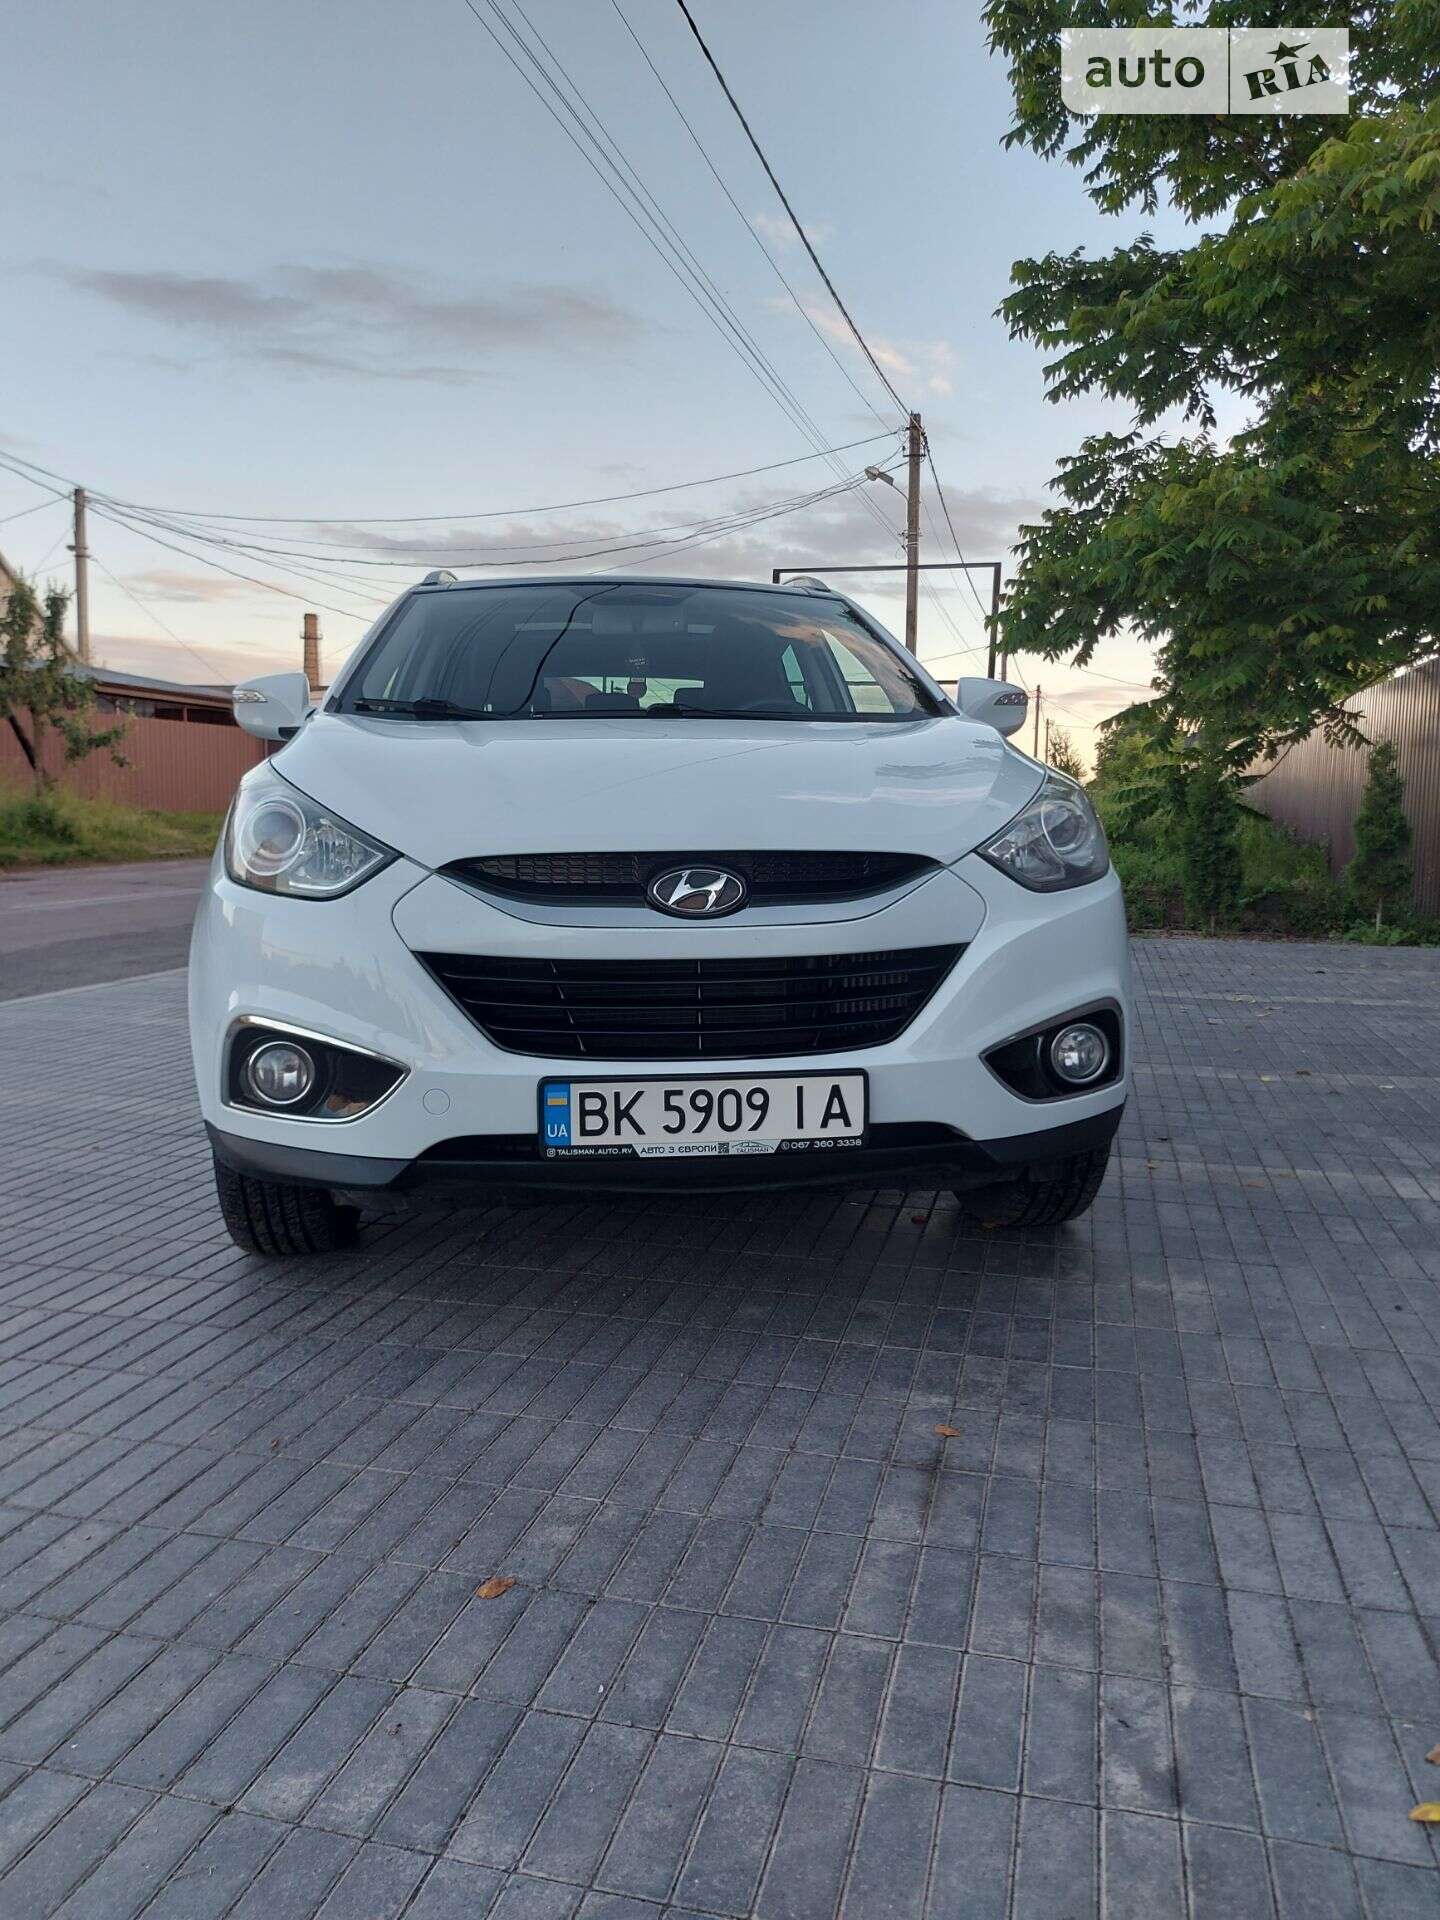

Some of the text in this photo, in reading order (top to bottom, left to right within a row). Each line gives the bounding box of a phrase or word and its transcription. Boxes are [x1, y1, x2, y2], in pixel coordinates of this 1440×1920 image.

[578, 1090, 646, 1137] BK
[662, 1086, 770, 1134] 5909
[547, 1124, 568, 1138] UA
